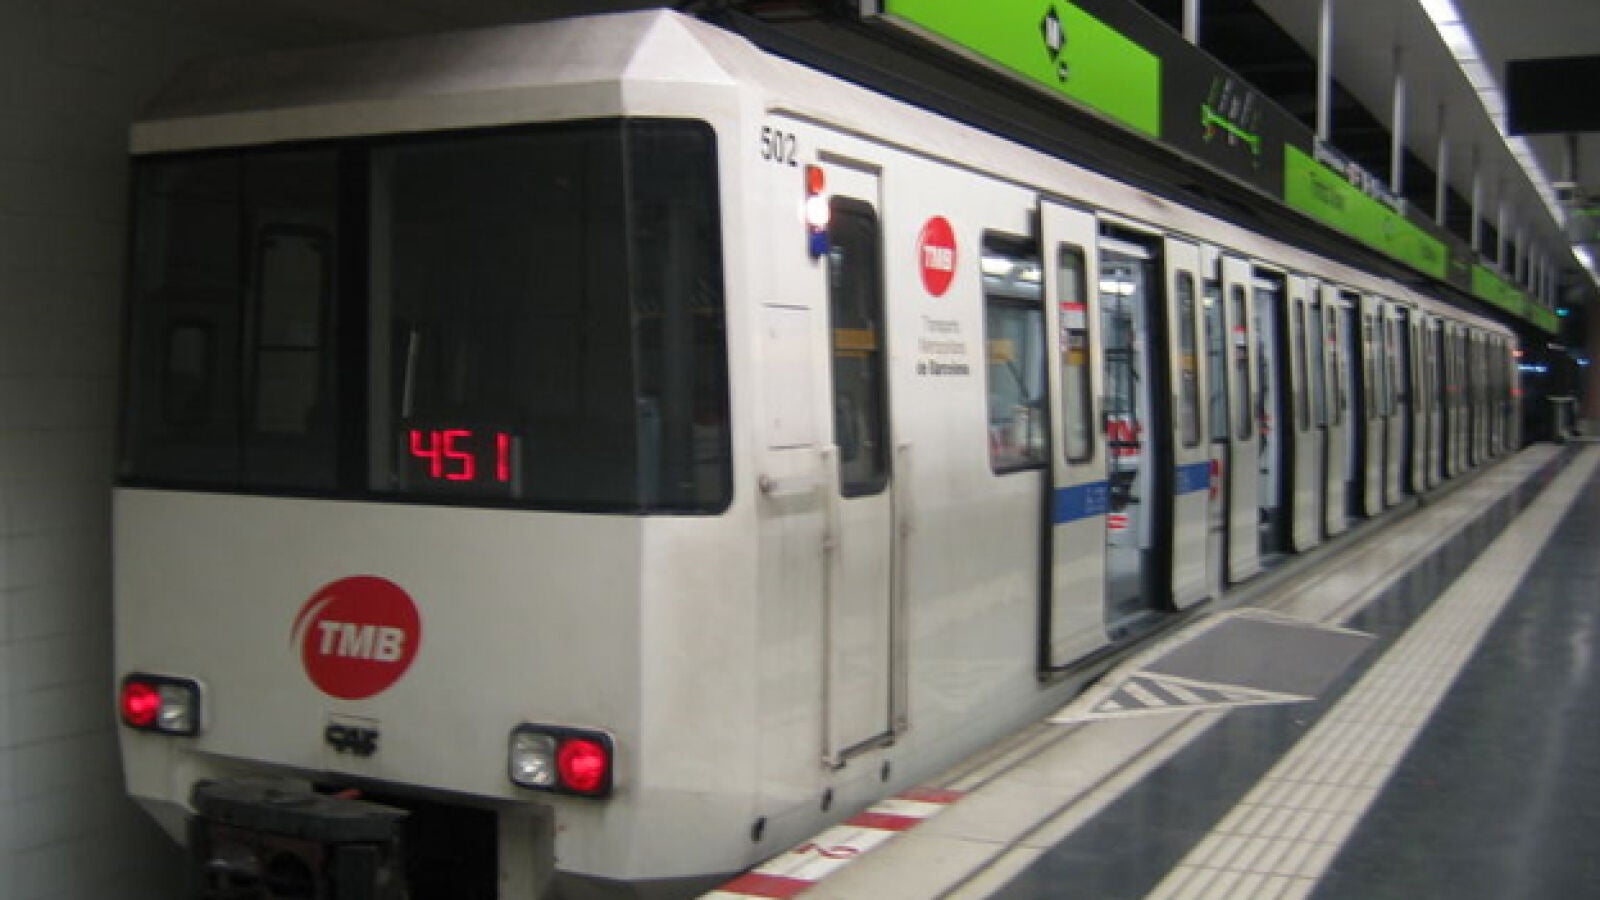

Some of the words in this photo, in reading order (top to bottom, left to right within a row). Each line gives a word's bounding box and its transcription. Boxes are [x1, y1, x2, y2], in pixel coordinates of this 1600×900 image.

[761, 126, 798, 167] 502
[922, 246, 953, 272] TMB
[409, 429, 511, 482] 451
[317, 619, 405, 662] TMB
